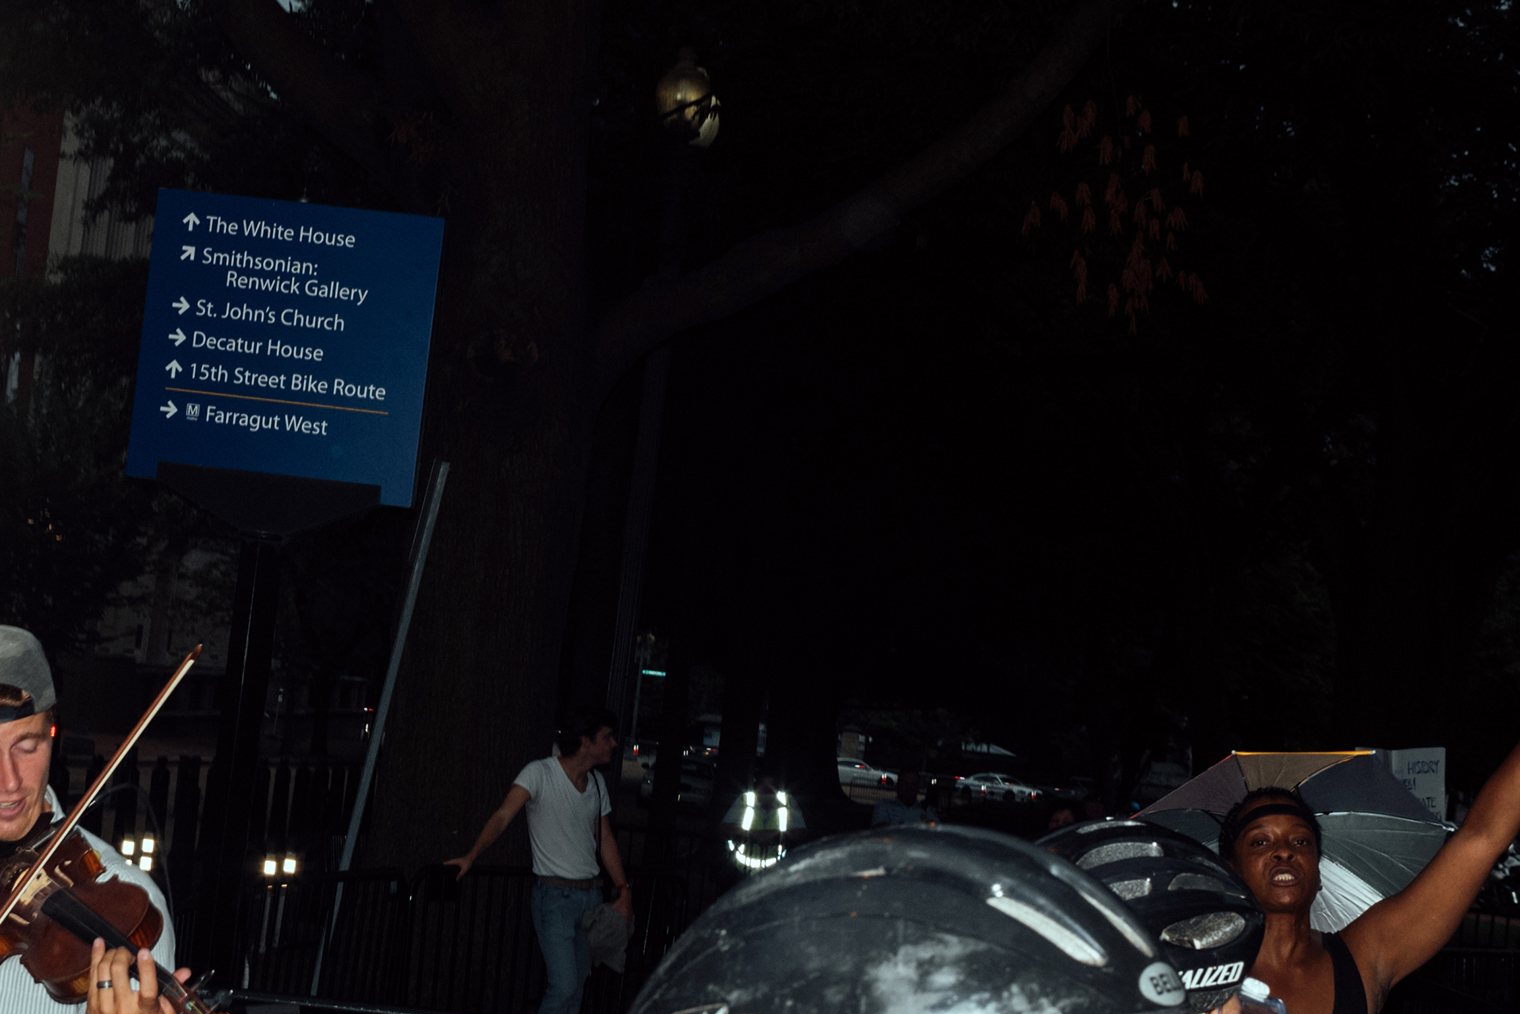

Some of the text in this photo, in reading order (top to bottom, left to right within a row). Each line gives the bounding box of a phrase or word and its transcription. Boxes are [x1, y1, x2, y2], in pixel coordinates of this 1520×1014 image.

[205, 214, 356, 248] The White House
[202, 247, 319, 276] Smithsonian:
[225, 270, 369, 306] Renwick Gallery
[195, 299, 346, 331] St. John's Church
[191, 331, 324, 362] Decatur House
[189, 362, 387, 400] 15th Street Bike Route
[205, 405, 280, 432] Farragut
[284, 414, 328, 436] West
[1177, 961, 1245, 990] ALIZED
